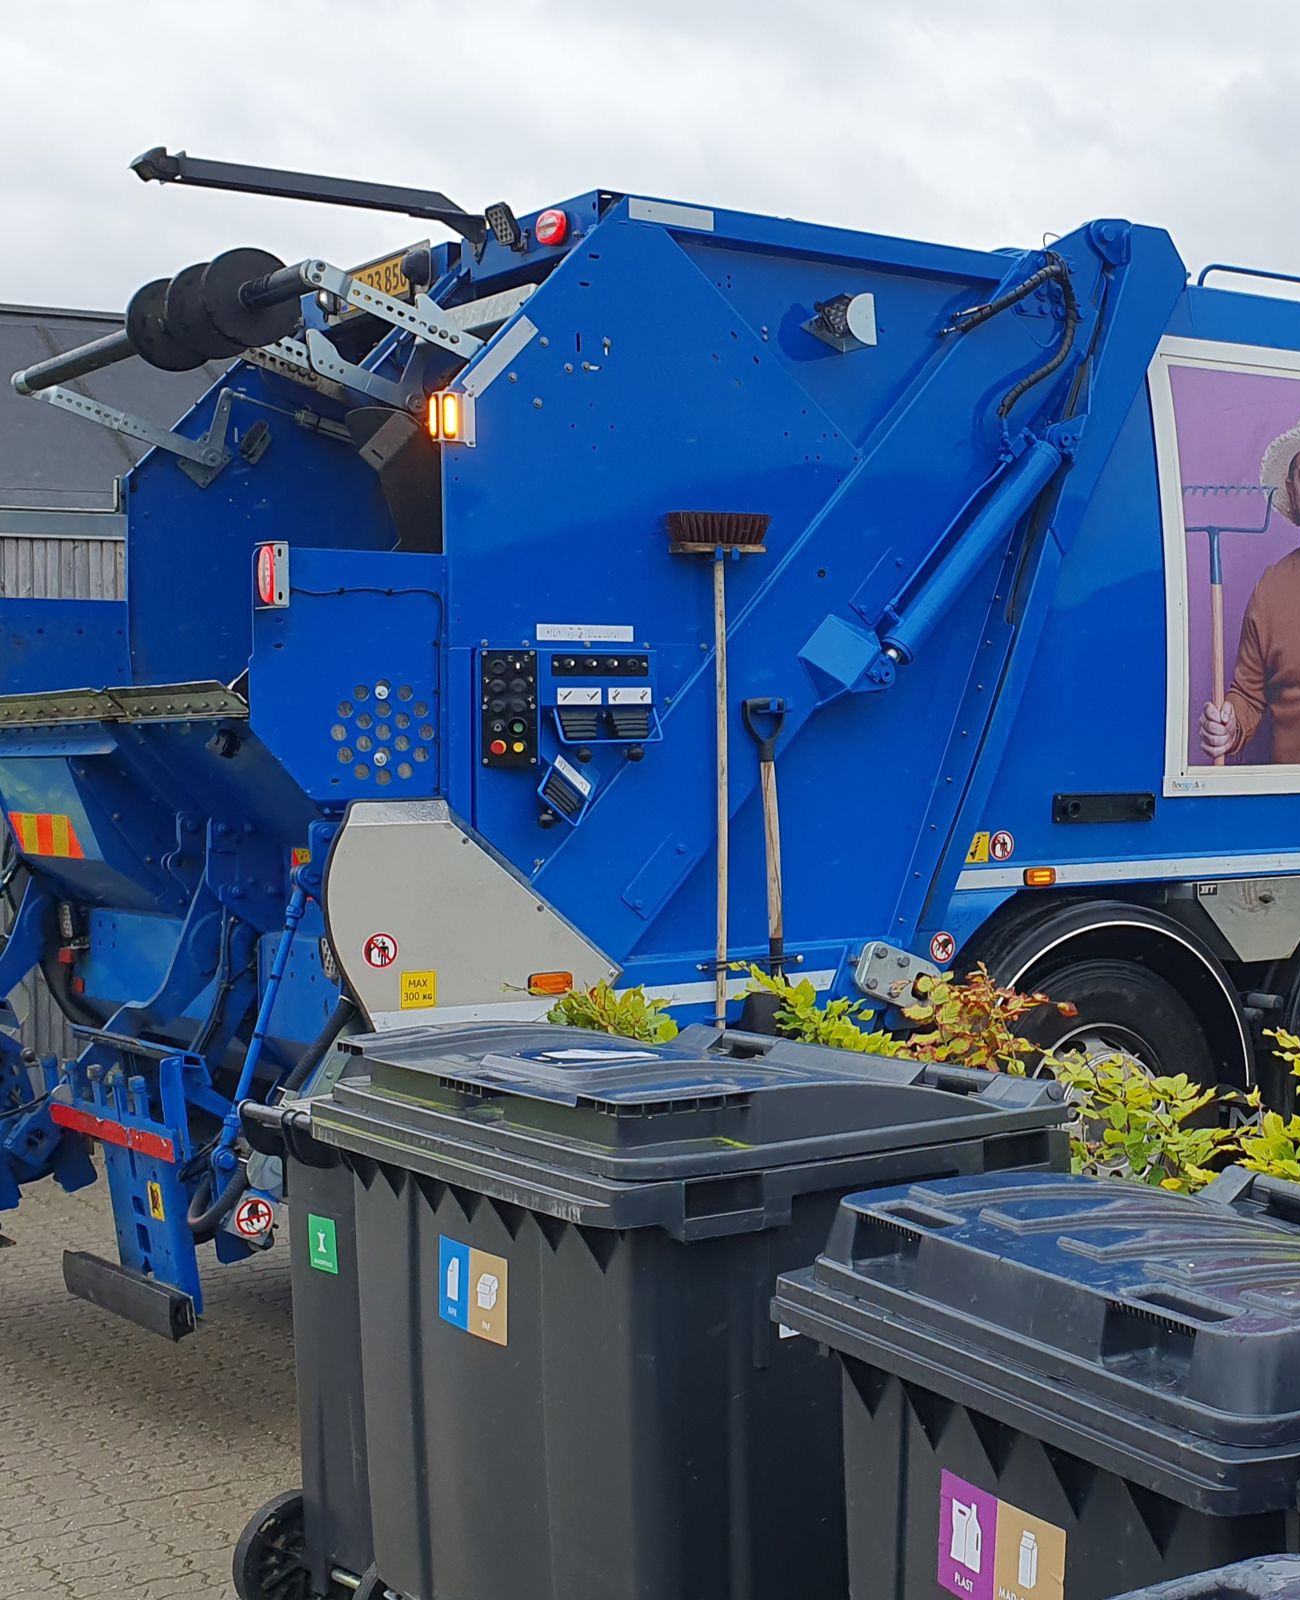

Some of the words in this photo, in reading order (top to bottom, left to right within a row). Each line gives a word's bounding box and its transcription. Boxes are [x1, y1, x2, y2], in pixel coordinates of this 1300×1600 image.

[408, 979, 428, 988] MAX
[403, 991, 420, 1002] 300
[422, 993, 433, 1001] KG
[955, 1571, 974, 1593] PLAST
